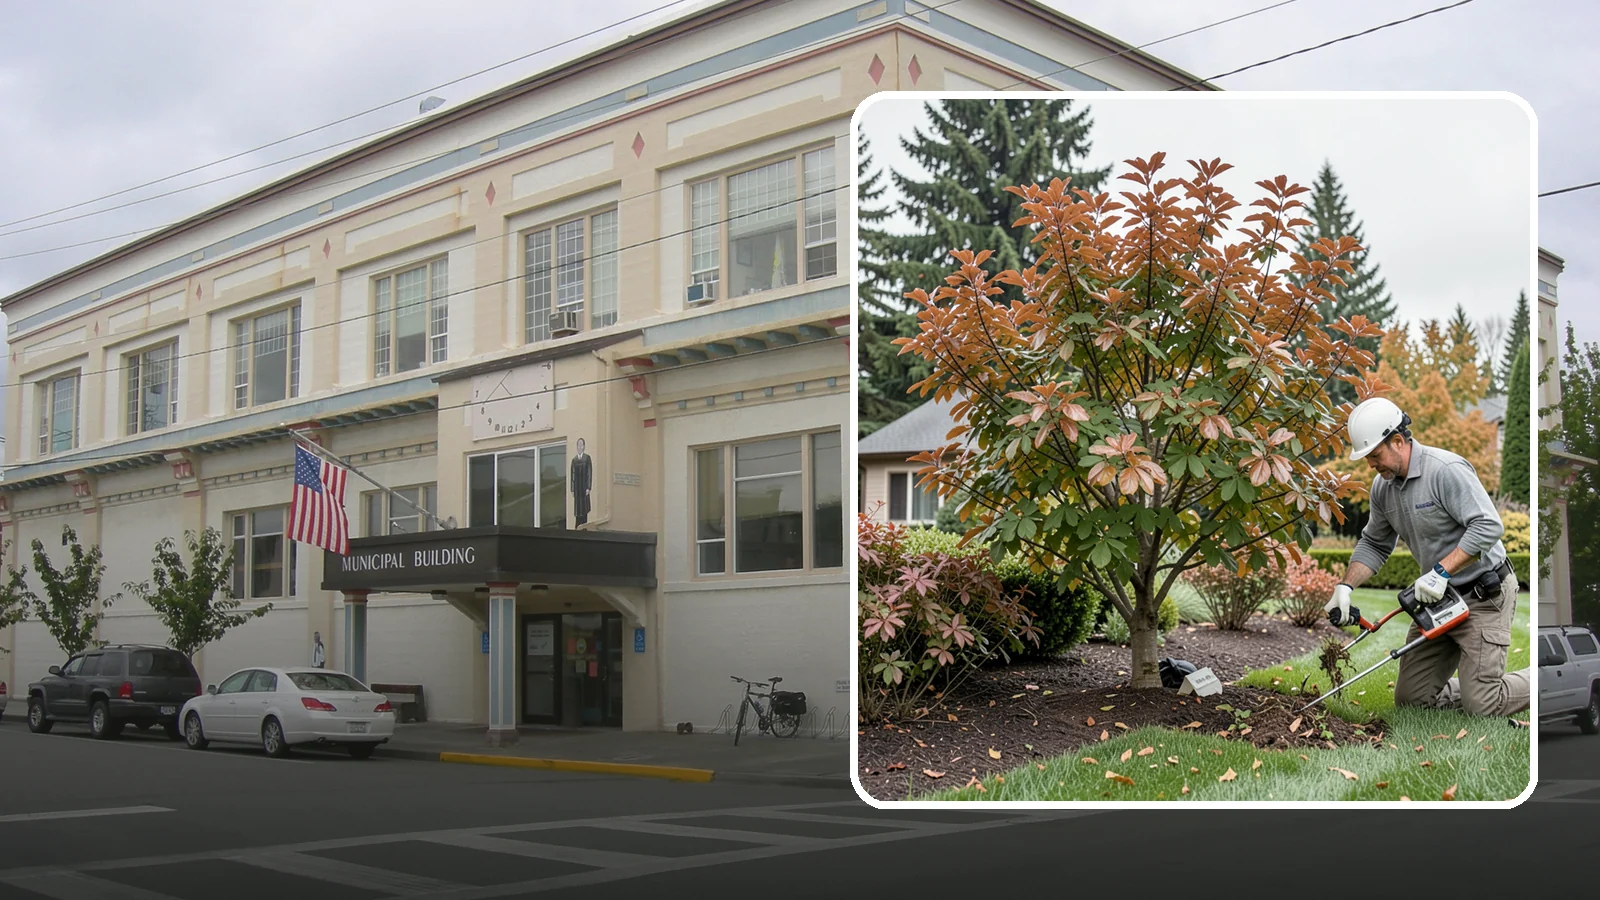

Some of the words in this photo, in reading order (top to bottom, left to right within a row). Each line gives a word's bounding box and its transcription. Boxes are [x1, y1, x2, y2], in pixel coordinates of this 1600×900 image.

[546, 361, 551, 370] 6
[475, 390, 479, 398] 7
[536, 402, 540, 410] 4
[480, 406, 484, 415] 8
[488, 418, 492, 426] 9
[528, 414, 532, 422] 3
[494, 424, 500, 432] 10
[521, 420, 526, 428] 2
[502, 426, 506, 434] 11
[508, 426, 513, 434] 12
[342, 552, 405, 572] MUNICIPAL
[414, 546, 475, 567] BUILDING
